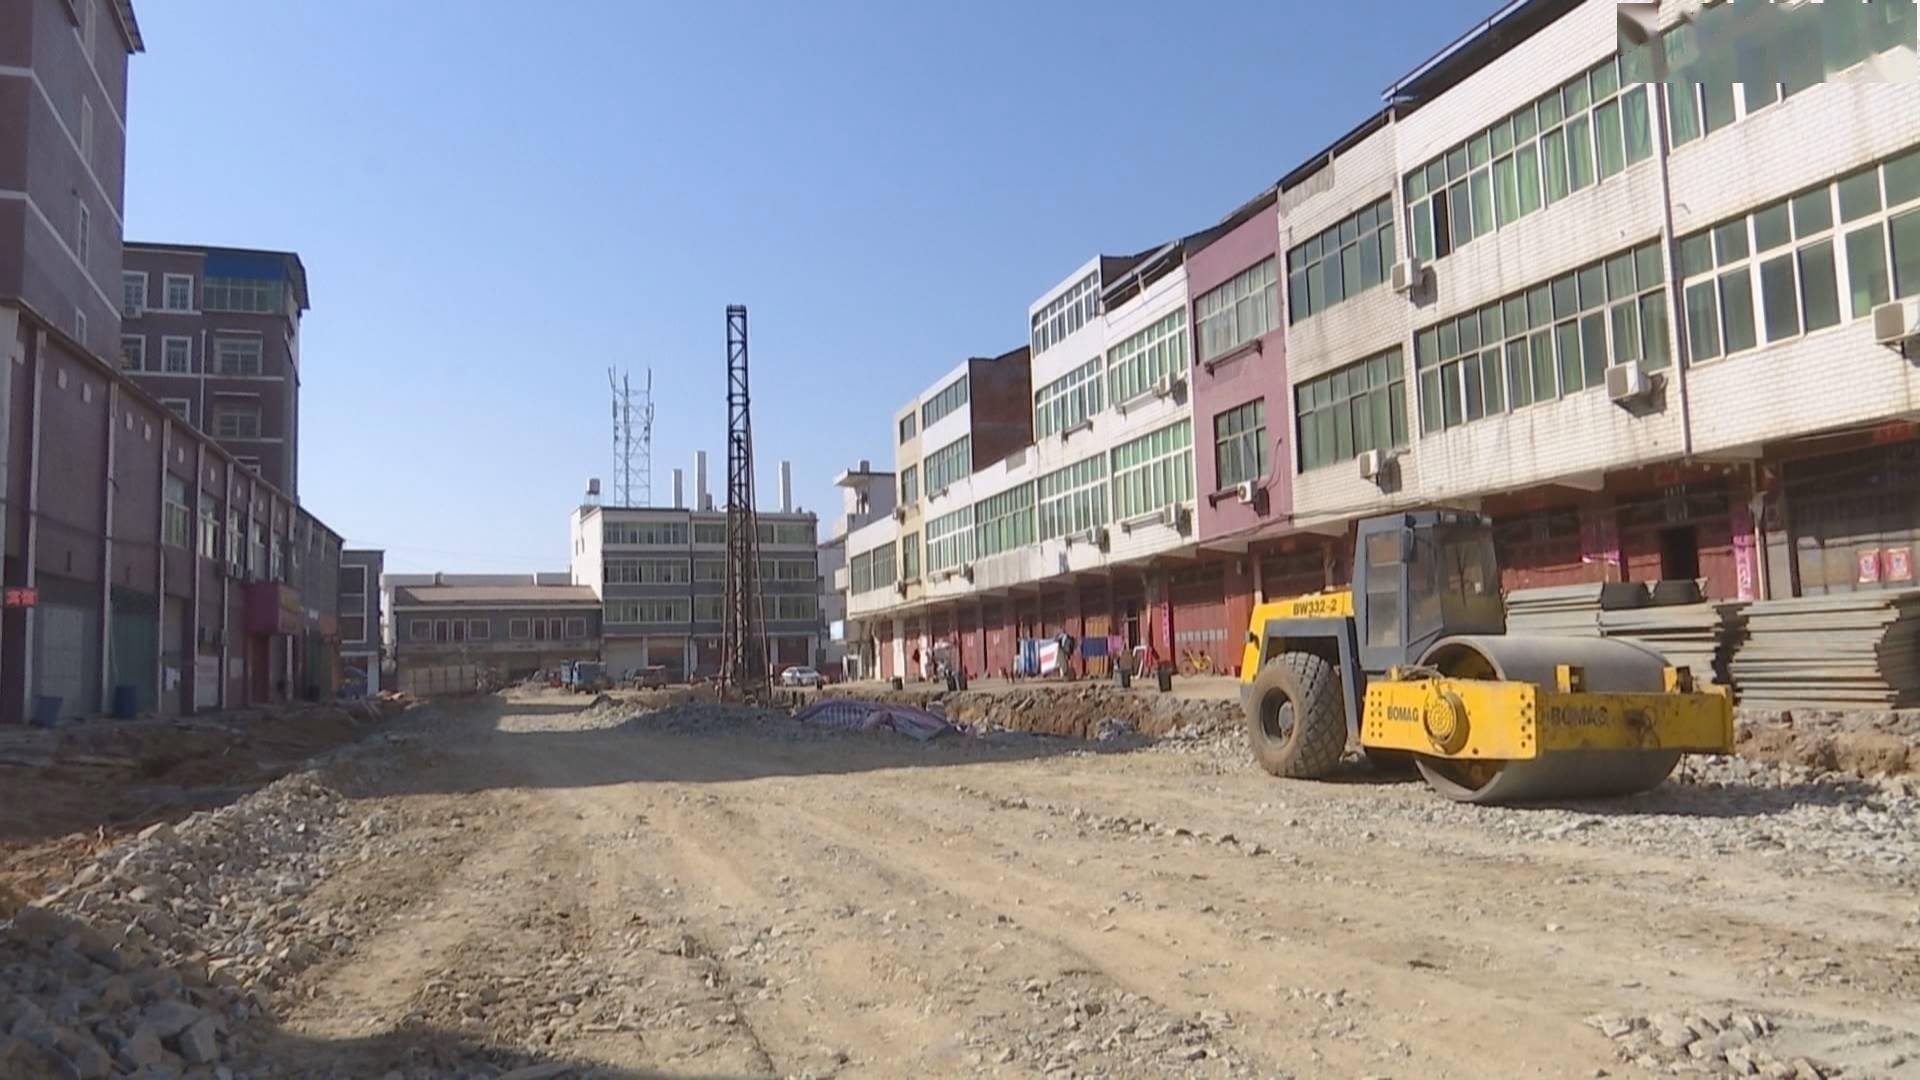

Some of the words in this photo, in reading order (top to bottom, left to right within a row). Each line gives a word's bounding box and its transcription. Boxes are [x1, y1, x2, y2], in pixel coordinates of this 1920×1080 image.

[1293, 599, 1338, 616] BW332-2
[1387, 705, 1419, 722] BOMAG
[1551, 705, 1608, 726] BOMAG
